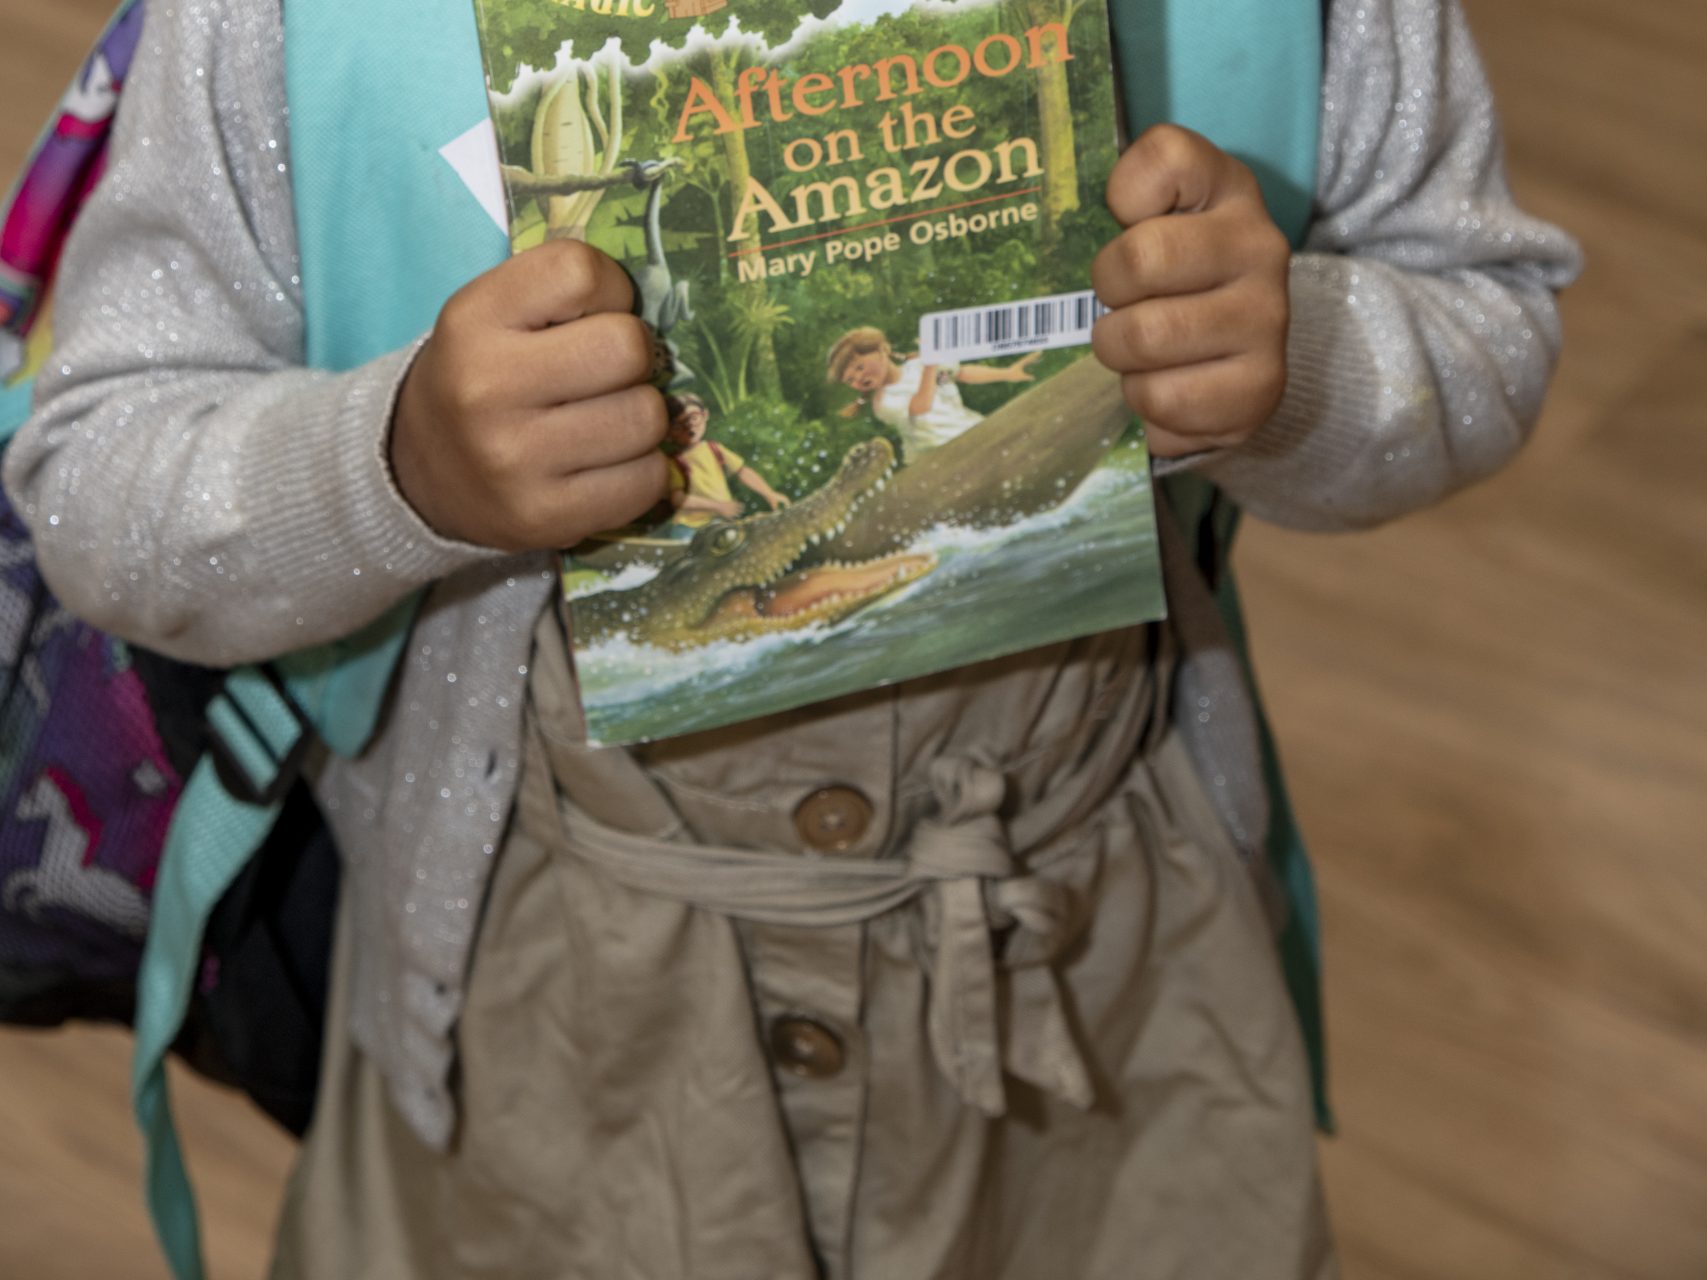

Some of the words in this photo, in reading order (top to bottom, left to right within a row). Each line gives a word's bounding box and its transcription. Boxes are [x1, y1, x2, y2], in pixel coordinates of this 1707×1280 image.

[672, 22, 1075, 144] Afternoon
[783, 128, 864, 173] on
[878, 101, 977, 154] the
[727, 136, 1045, 242] Amazon
[738, 250, 816, 283] Mary
[825, 232, 900, 263] Pope
[910, 202, 1038, 245] Osborne
